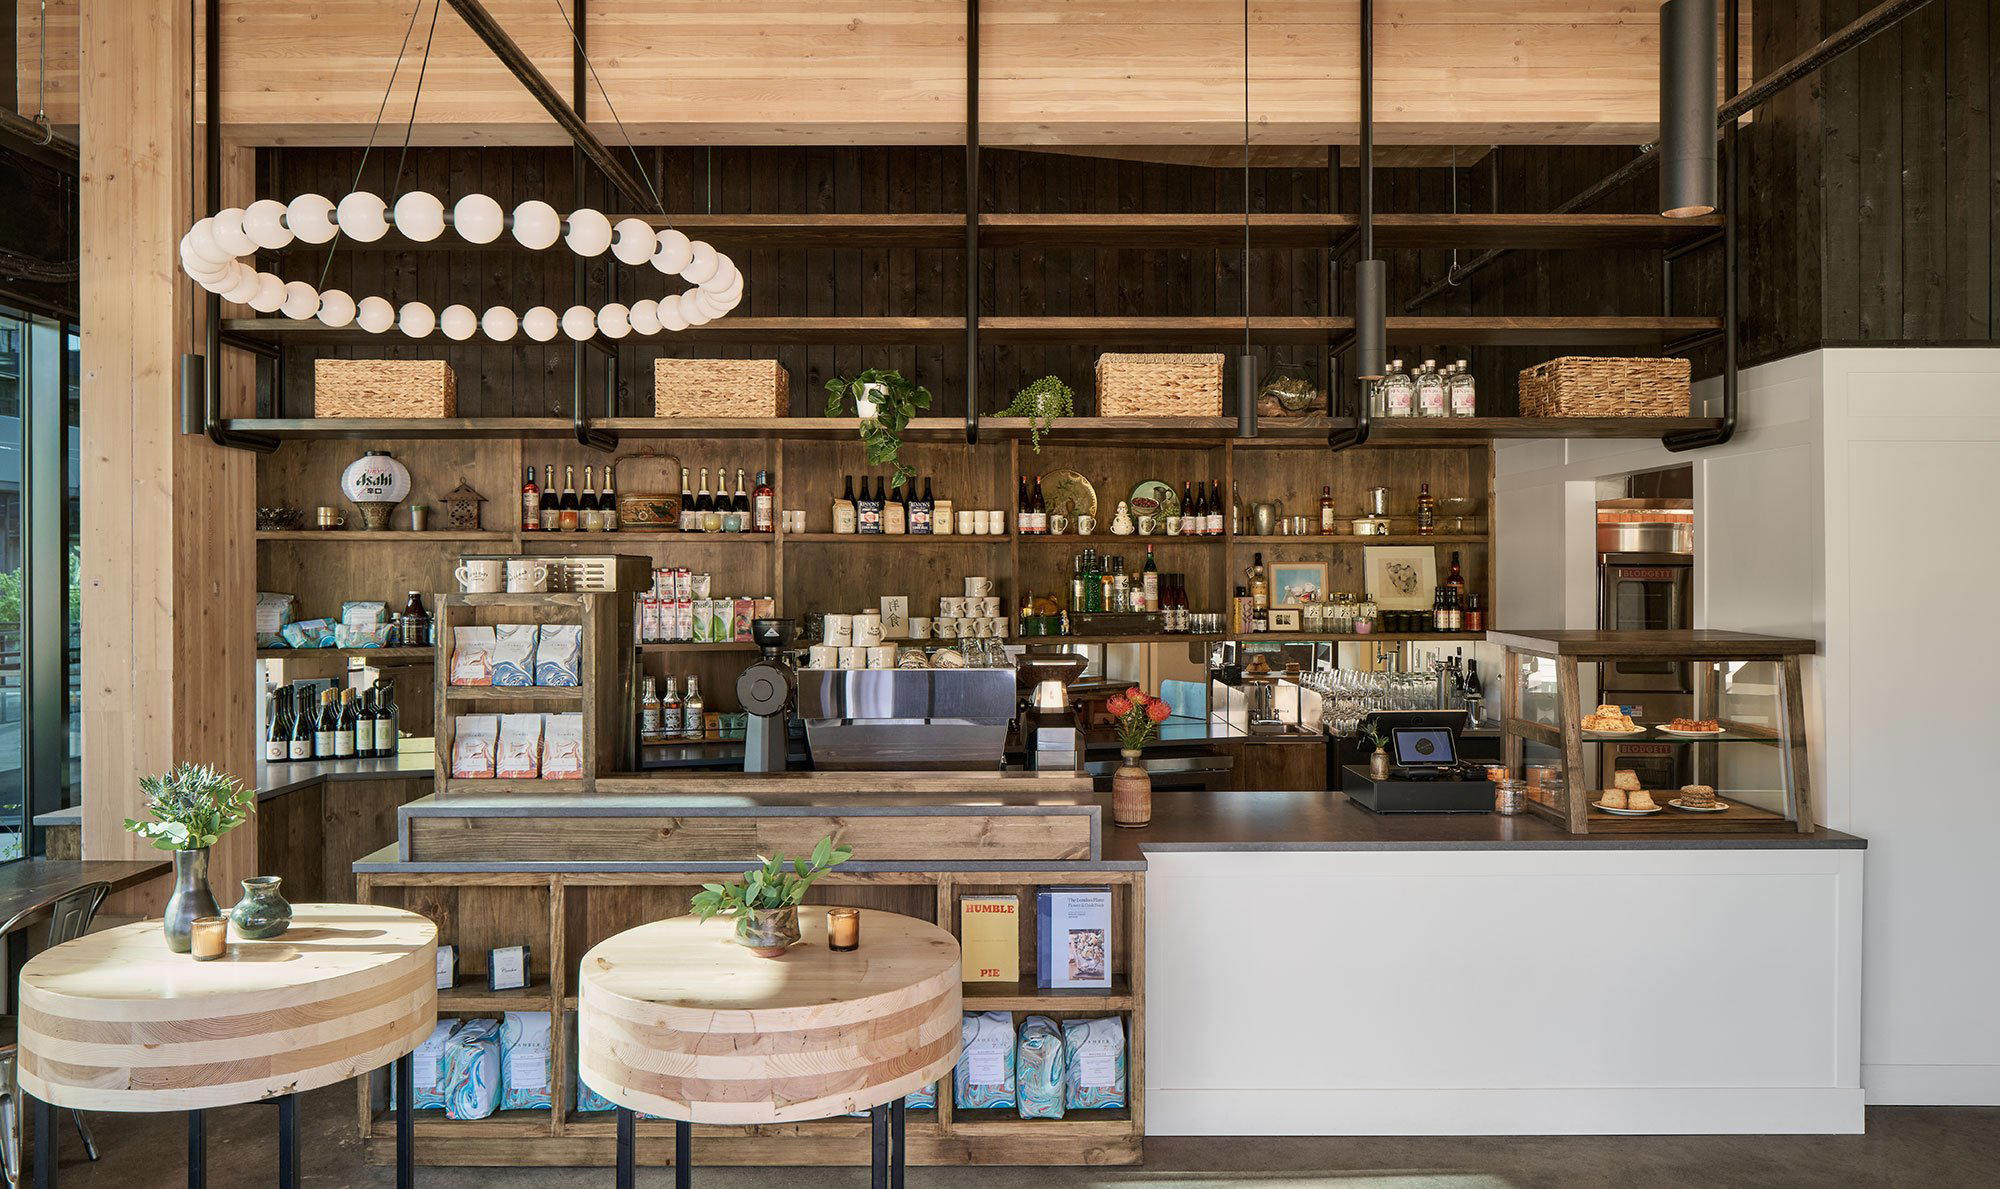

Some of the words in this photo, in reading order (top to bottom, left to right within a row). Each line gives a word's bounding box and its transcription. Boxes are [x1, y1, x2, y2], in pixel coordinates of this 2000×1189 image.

[356, 472, 392, 486] Asahi
[1623, 569, 1671, 578] BLODGETT
[887, 598, 901, 628] 洋食
[965, 904, 1014, 914] HUMBLE
[980, 968, 1000, 977] PIE
